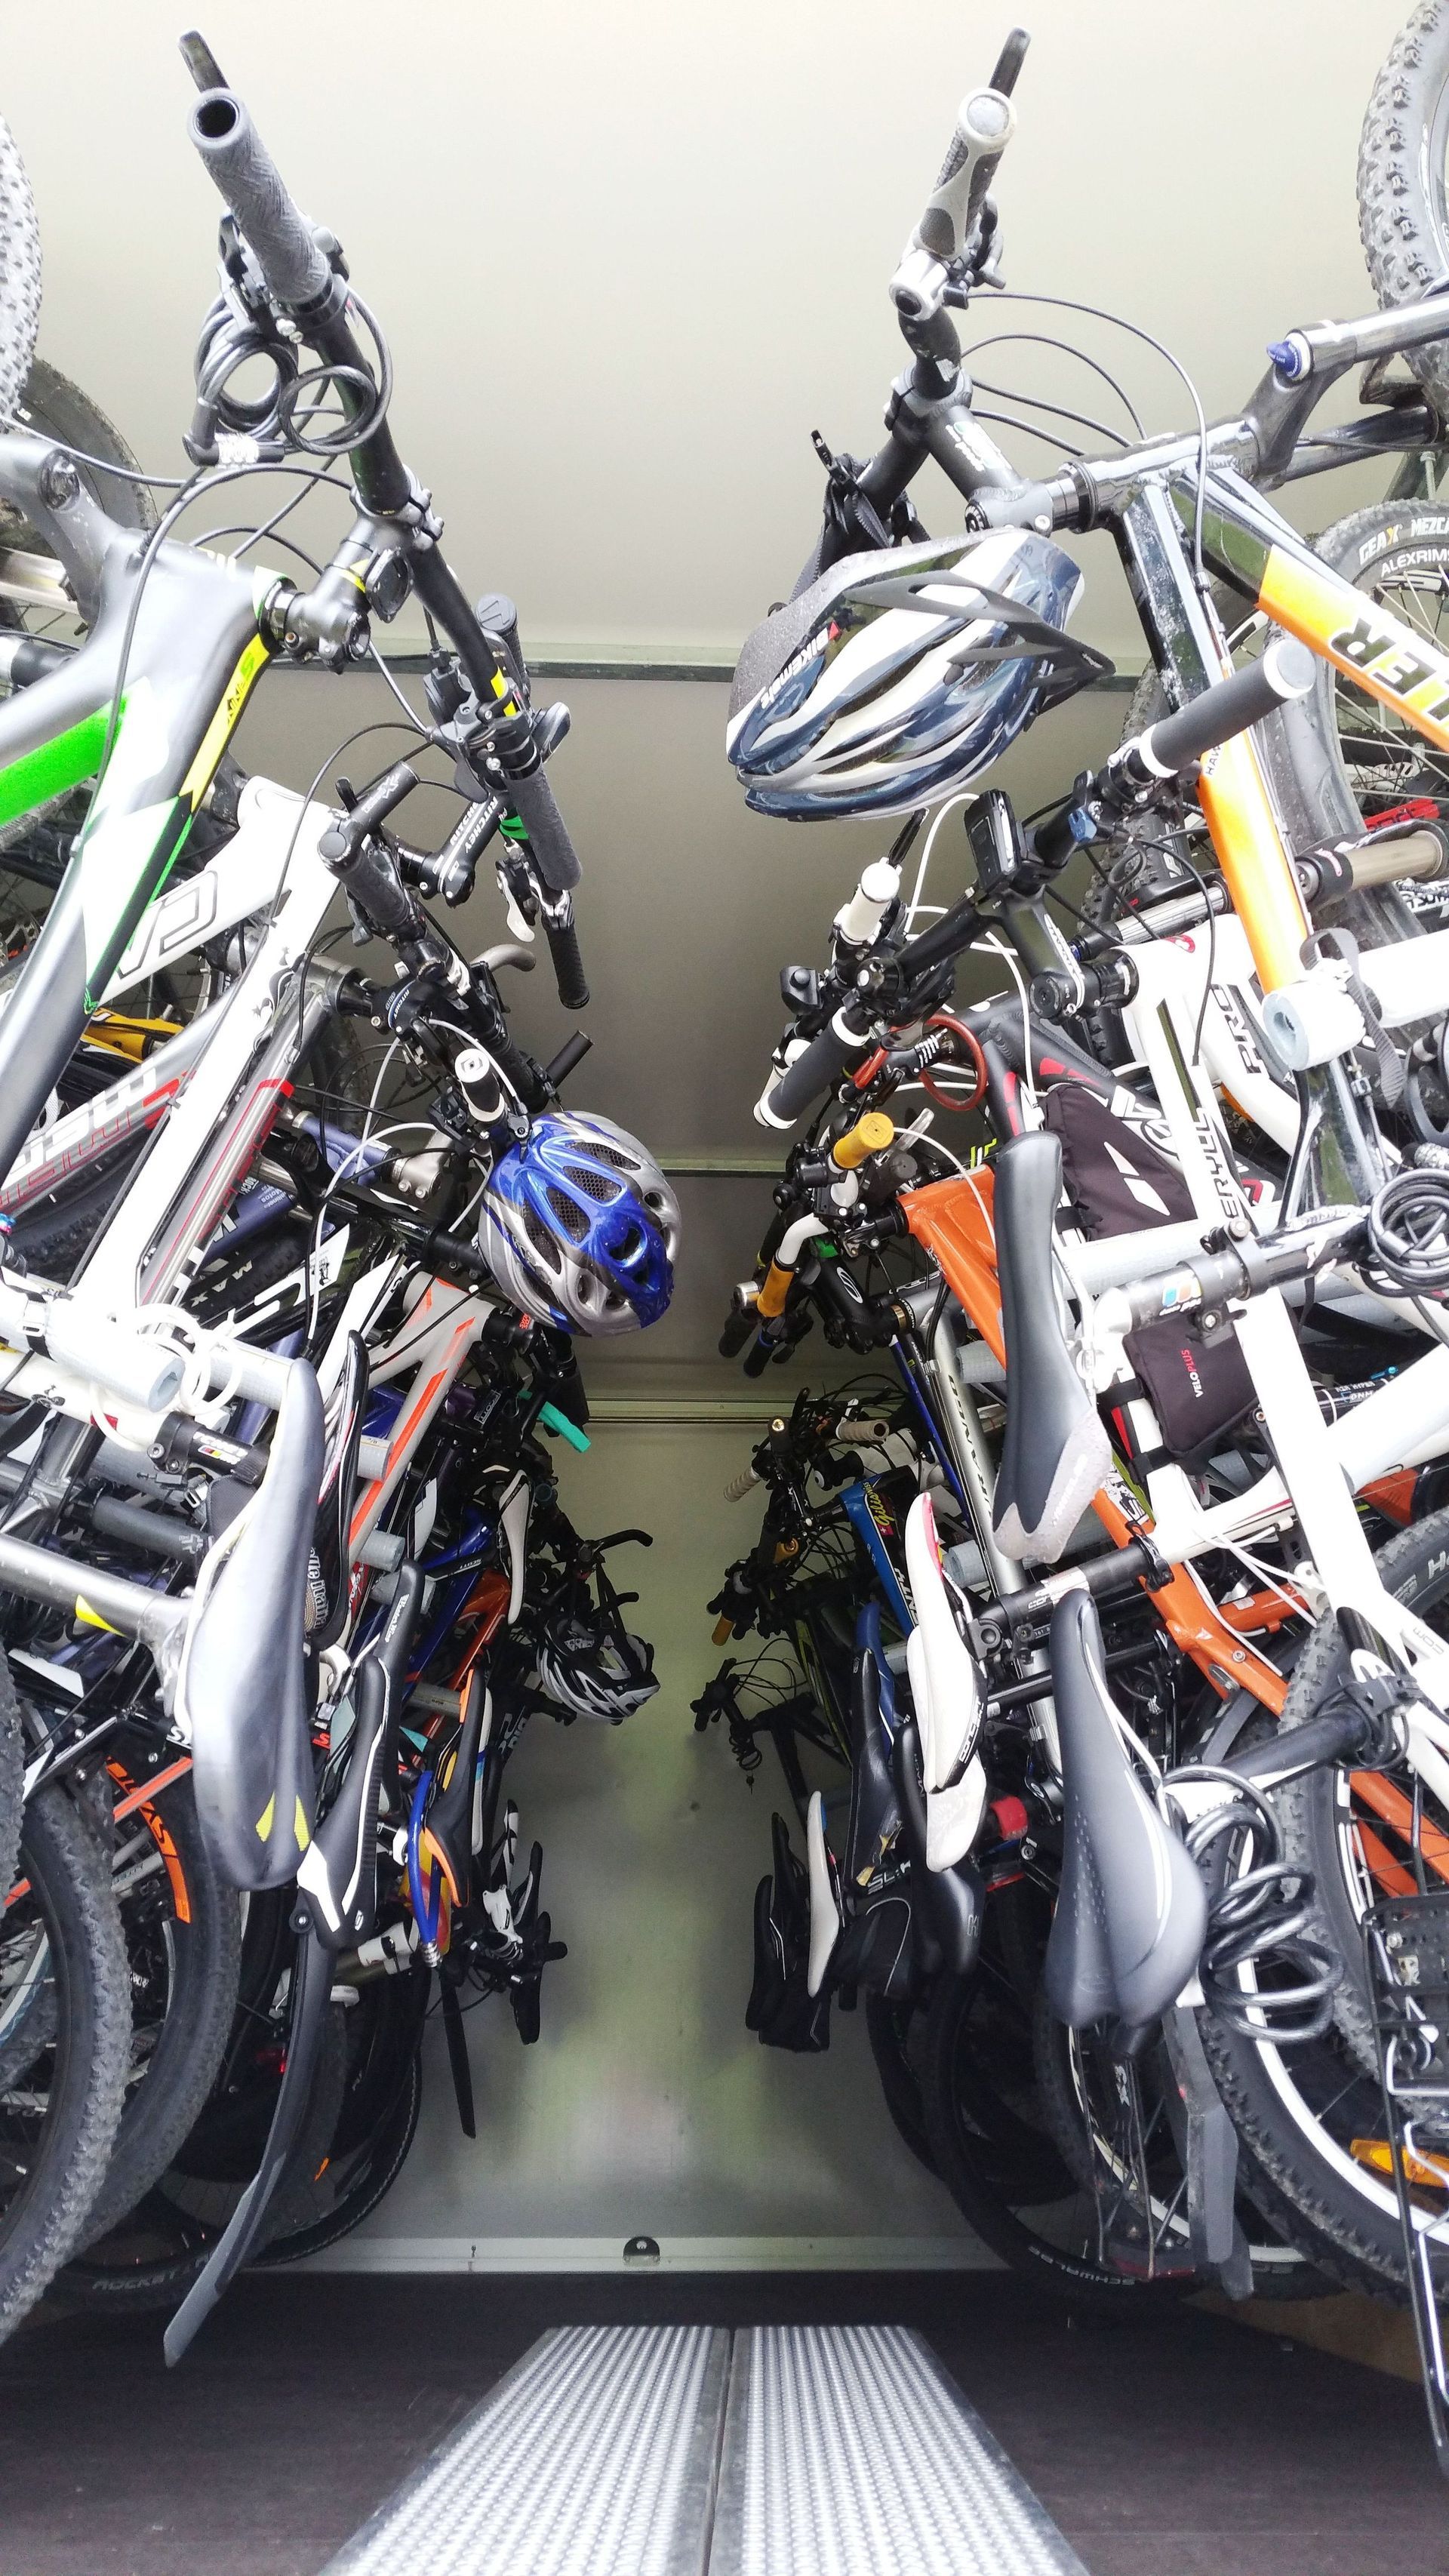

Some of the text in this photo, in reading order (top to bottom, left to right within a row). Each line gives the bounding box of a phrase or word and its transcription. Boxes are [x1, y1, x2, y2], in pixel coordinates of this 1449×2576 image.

[1359, 524, 1400, 565] GEAX
[449, 801, 478, 846] RITCHE
[464, 796, 498, 854] RITCHEY
[393, 989, 410, 1020] RITCHEY
[1195, 1108, 1239, 1218] ERYLL
[190, 1259, 253, 1308] MAX
[1180, 1348, 1204, 1398] VELOPLUS
[948, 1374, 992, 1519] URANGO
[894, 1567, 920, 1626] ENTY
